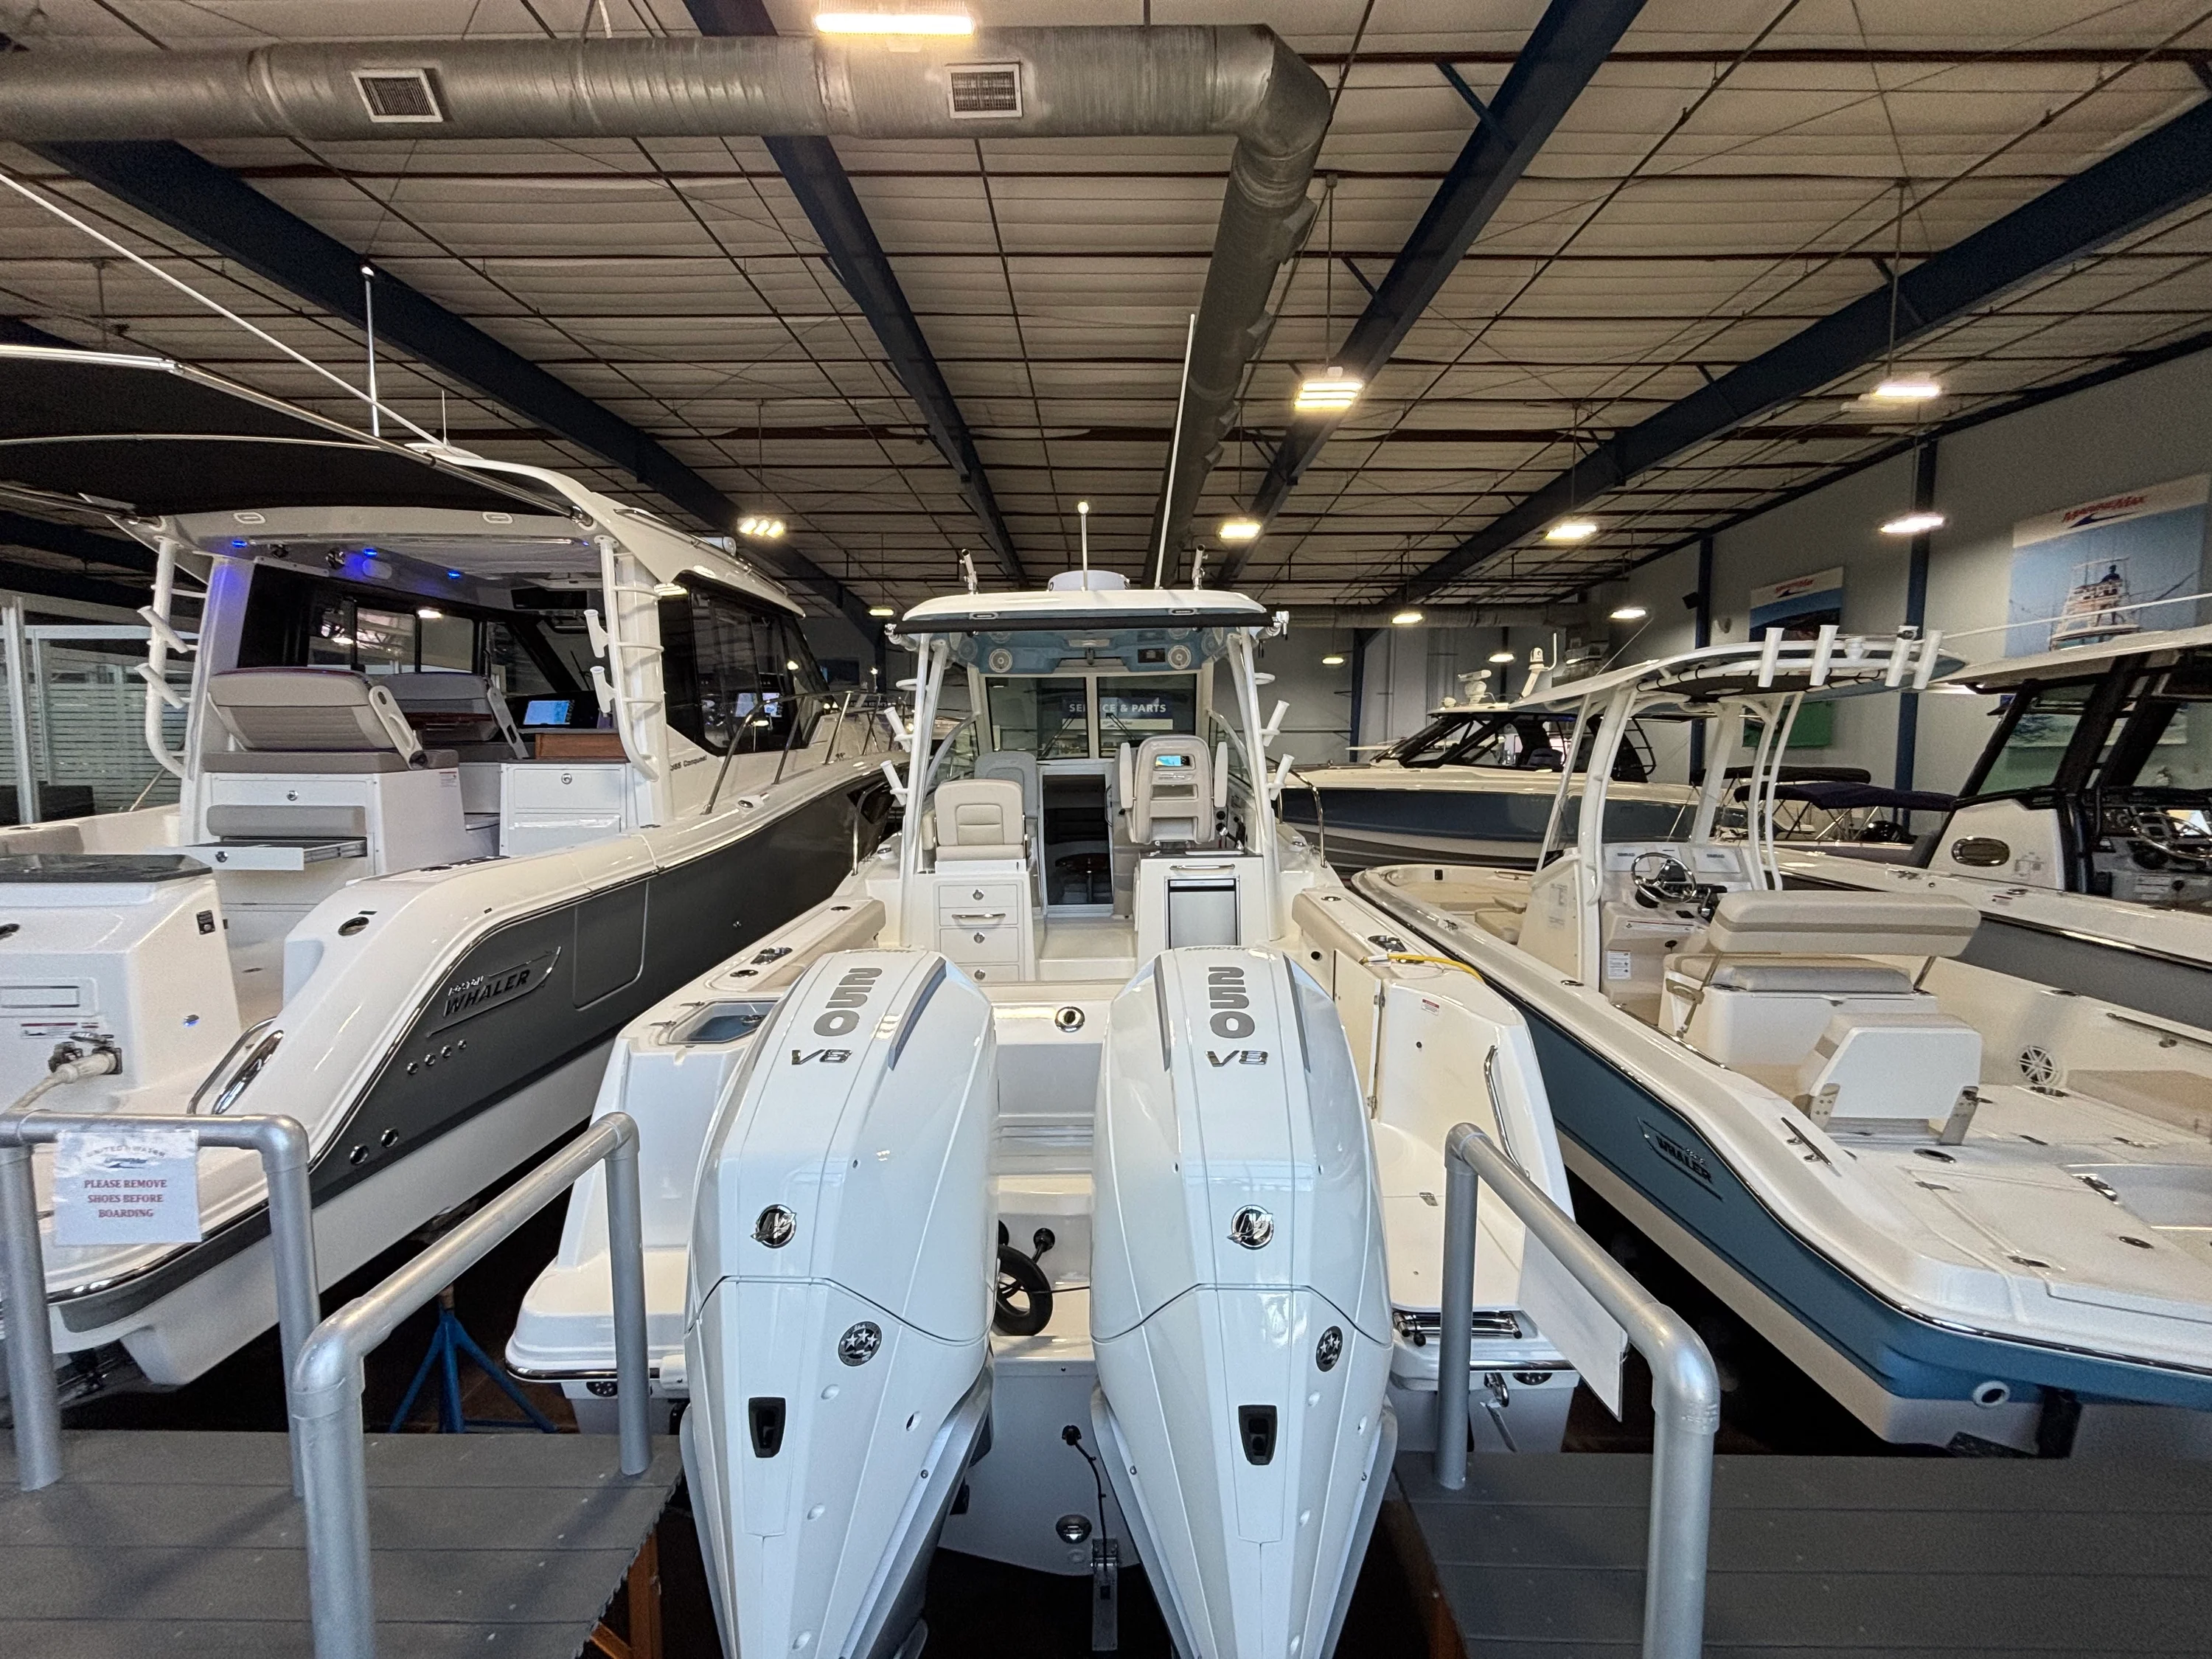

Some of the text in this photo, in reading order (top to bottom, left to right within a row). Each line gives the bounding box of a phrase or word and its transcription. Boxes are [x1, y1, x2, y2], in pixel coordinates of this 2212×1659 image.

[1120, 704, 1127, 712] &
[1132, 704, 1166, 712] PARTS
[443, 969, 530, 1018] WHALER
[813, 967, 883, 1037] 250
[1208, 967, 1256, 1039] 250
[791, 1048, 853, 1065] V8
[1204, 1050, 1269, 1068] V8
[84, 1180, 167, 1189] PLEASE REMOVE
[87, 1194, 164, 1203] SHOES BEFORE
[98, 1209, 153, 1218] BOARDING
